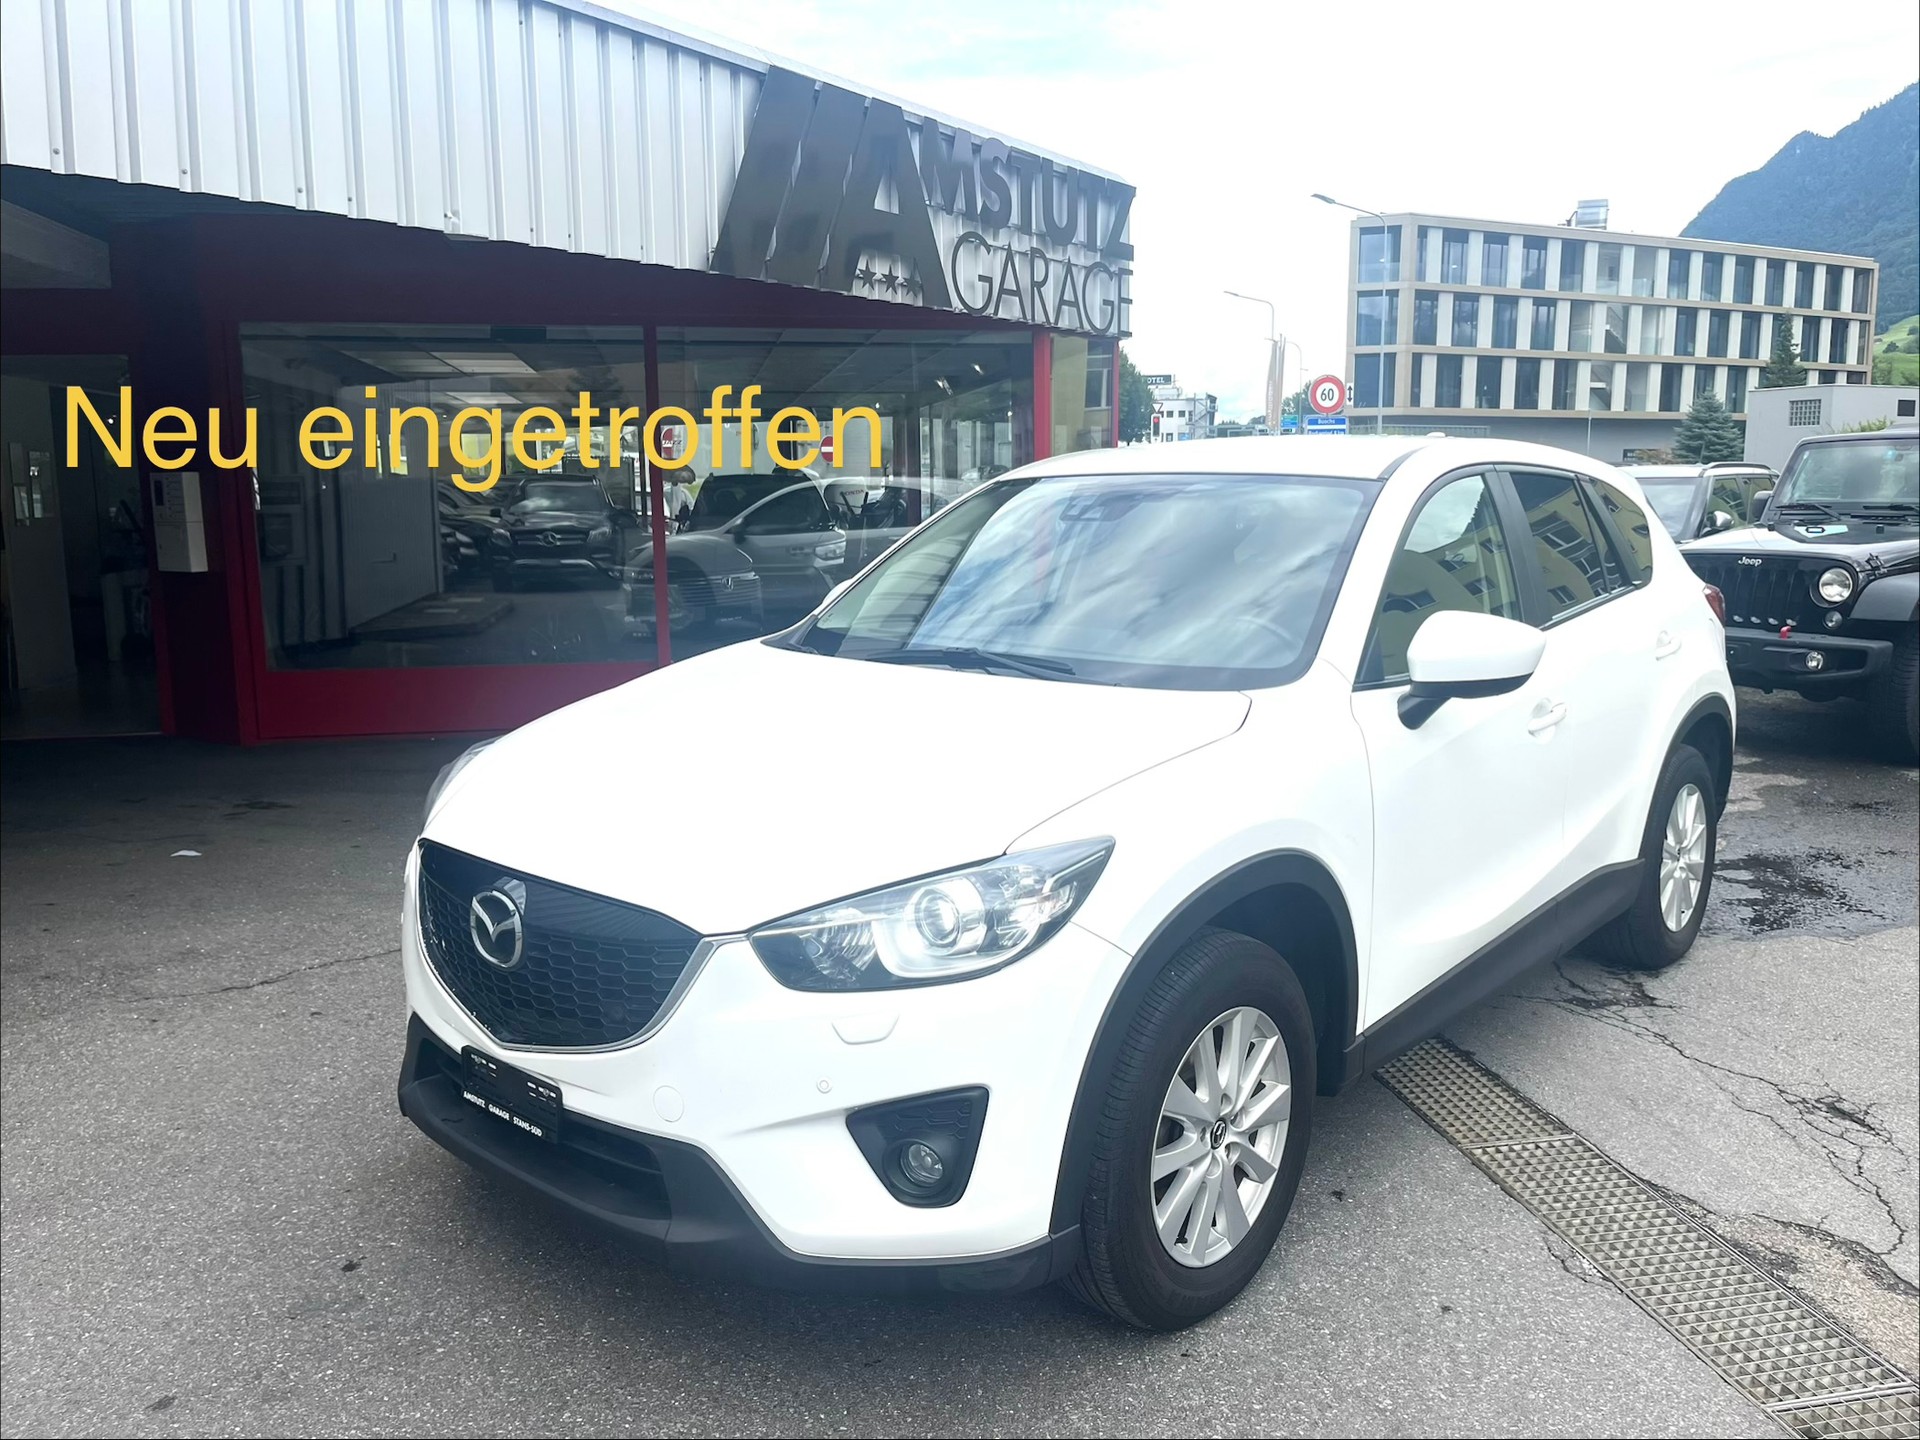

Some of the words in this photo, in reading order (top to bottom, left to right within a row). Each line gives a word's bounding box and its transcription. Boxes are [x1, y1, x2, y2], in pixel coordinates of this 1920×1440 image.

[815, 97, 1136, 309] AMSTUTZ
[951, 231, 1133, 337] GARAGE
[1320, 388, 1334, 401] 60
[1738, 556, 1762, 567] Jeep
[488, 1104, 510, 1121] GARAGE
